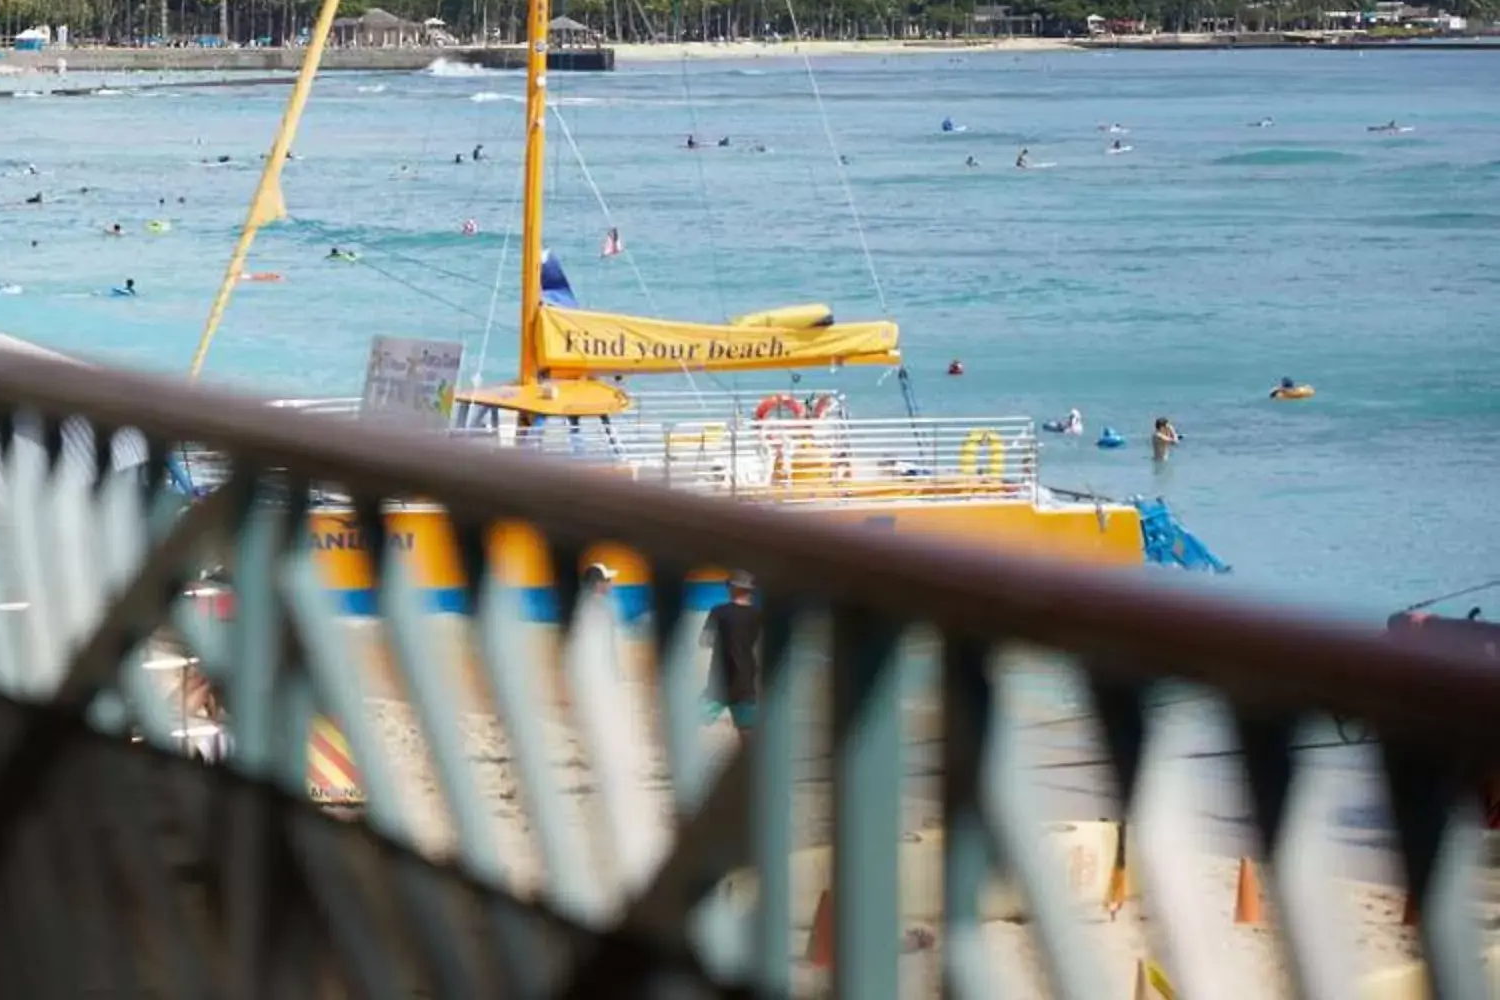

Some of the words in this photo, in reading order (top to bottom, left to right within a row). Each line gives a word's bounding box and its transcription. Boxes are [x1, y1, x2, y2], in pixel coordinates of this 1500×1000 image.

[565, 329, 626, 357] Find
[631, 340, 700, 364] your
[707, 335, 791, 360] beach.
